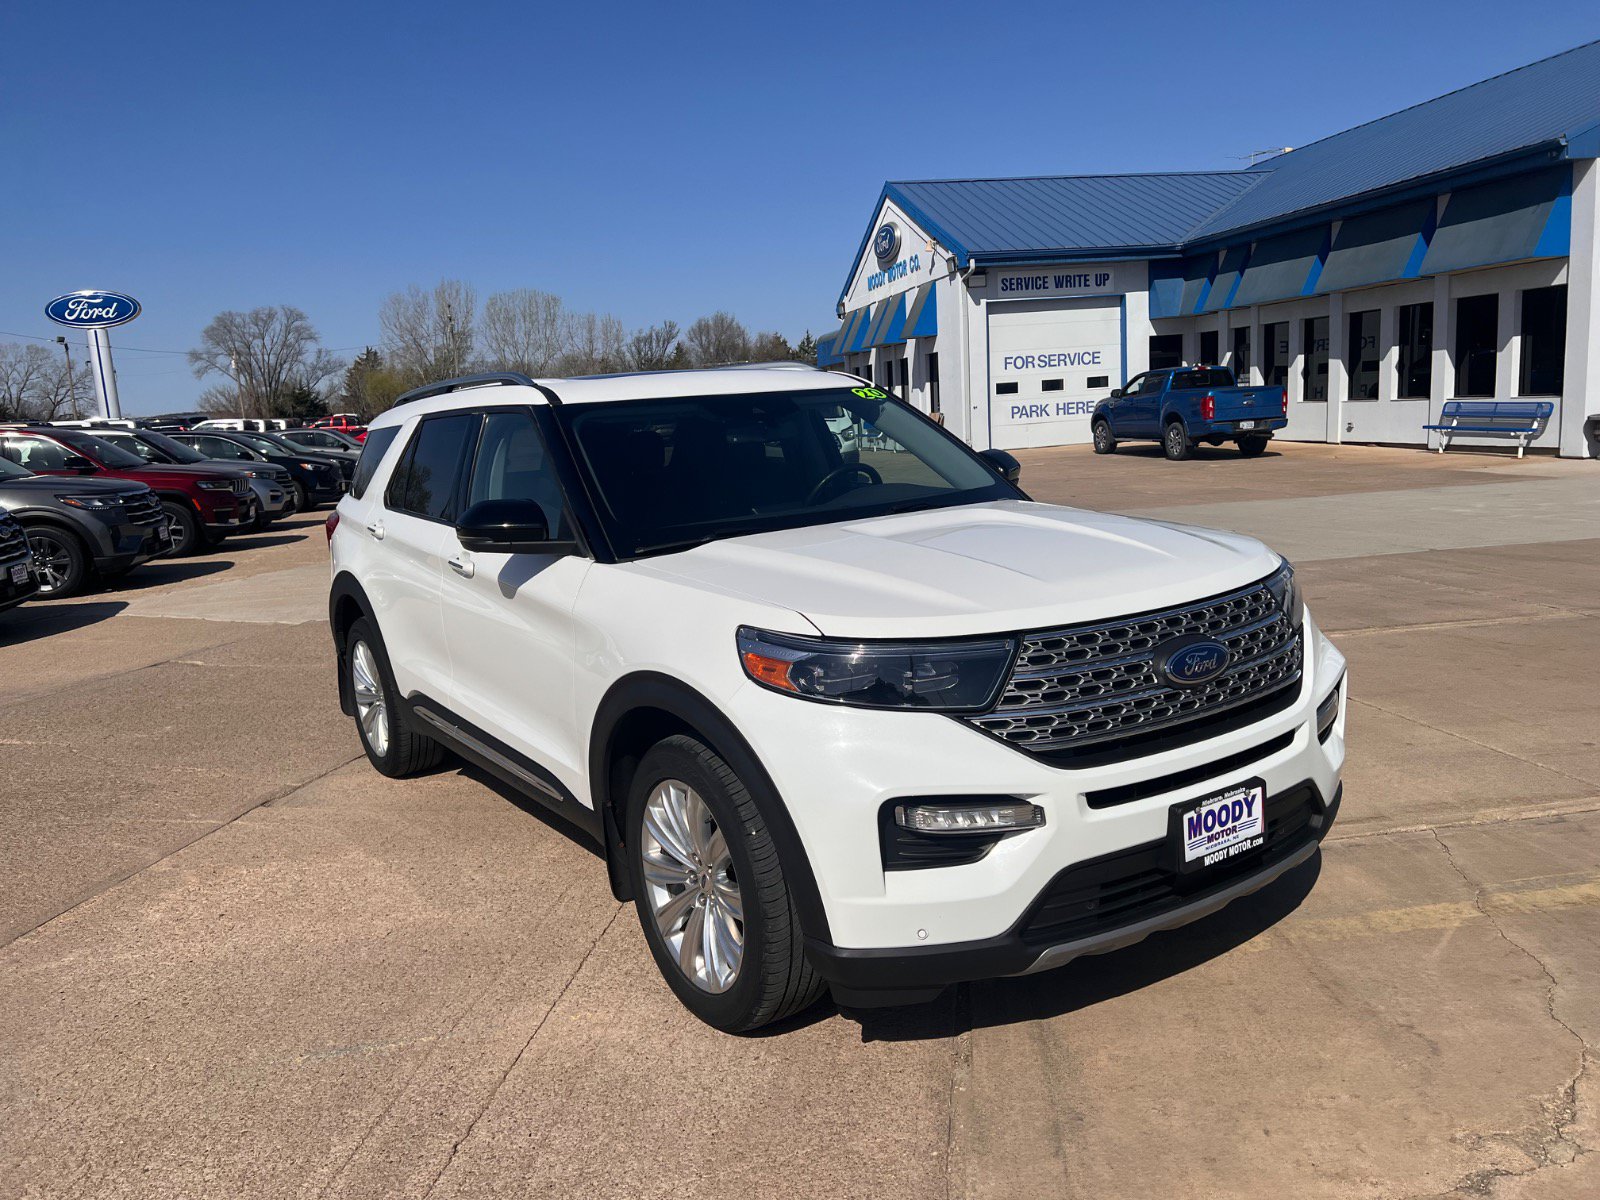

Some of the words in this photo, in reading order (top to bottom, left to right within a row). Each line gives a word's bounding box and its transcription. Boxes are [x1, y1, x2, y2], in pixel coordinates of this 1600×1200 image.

[867, 270, 886, 292] MOODY
[887, 259, 908, 283] MOTOR
[909, 254, 921, 274] CO.
[1001, 275, 1049, 292] SERVICE
[1053, 273, 1091, 289] WRITE
[1094, 273, 1110, 287] UP
[64, 298, 118, 320] Ford
[1004, 355, 1036, 370] FOR
[1037, 351, 1101, 368] SERVICE
[1011, 403, 1050, 419] PARK
[1055, 400, 1095, 416] HERE
[1184, 650, 1217, 676] Ford
[1187, 793, 1257, 840] MOODY
[1206, 824, 1238, 844] MOTOR
[1203, 848, 1228, 867] MOODY
